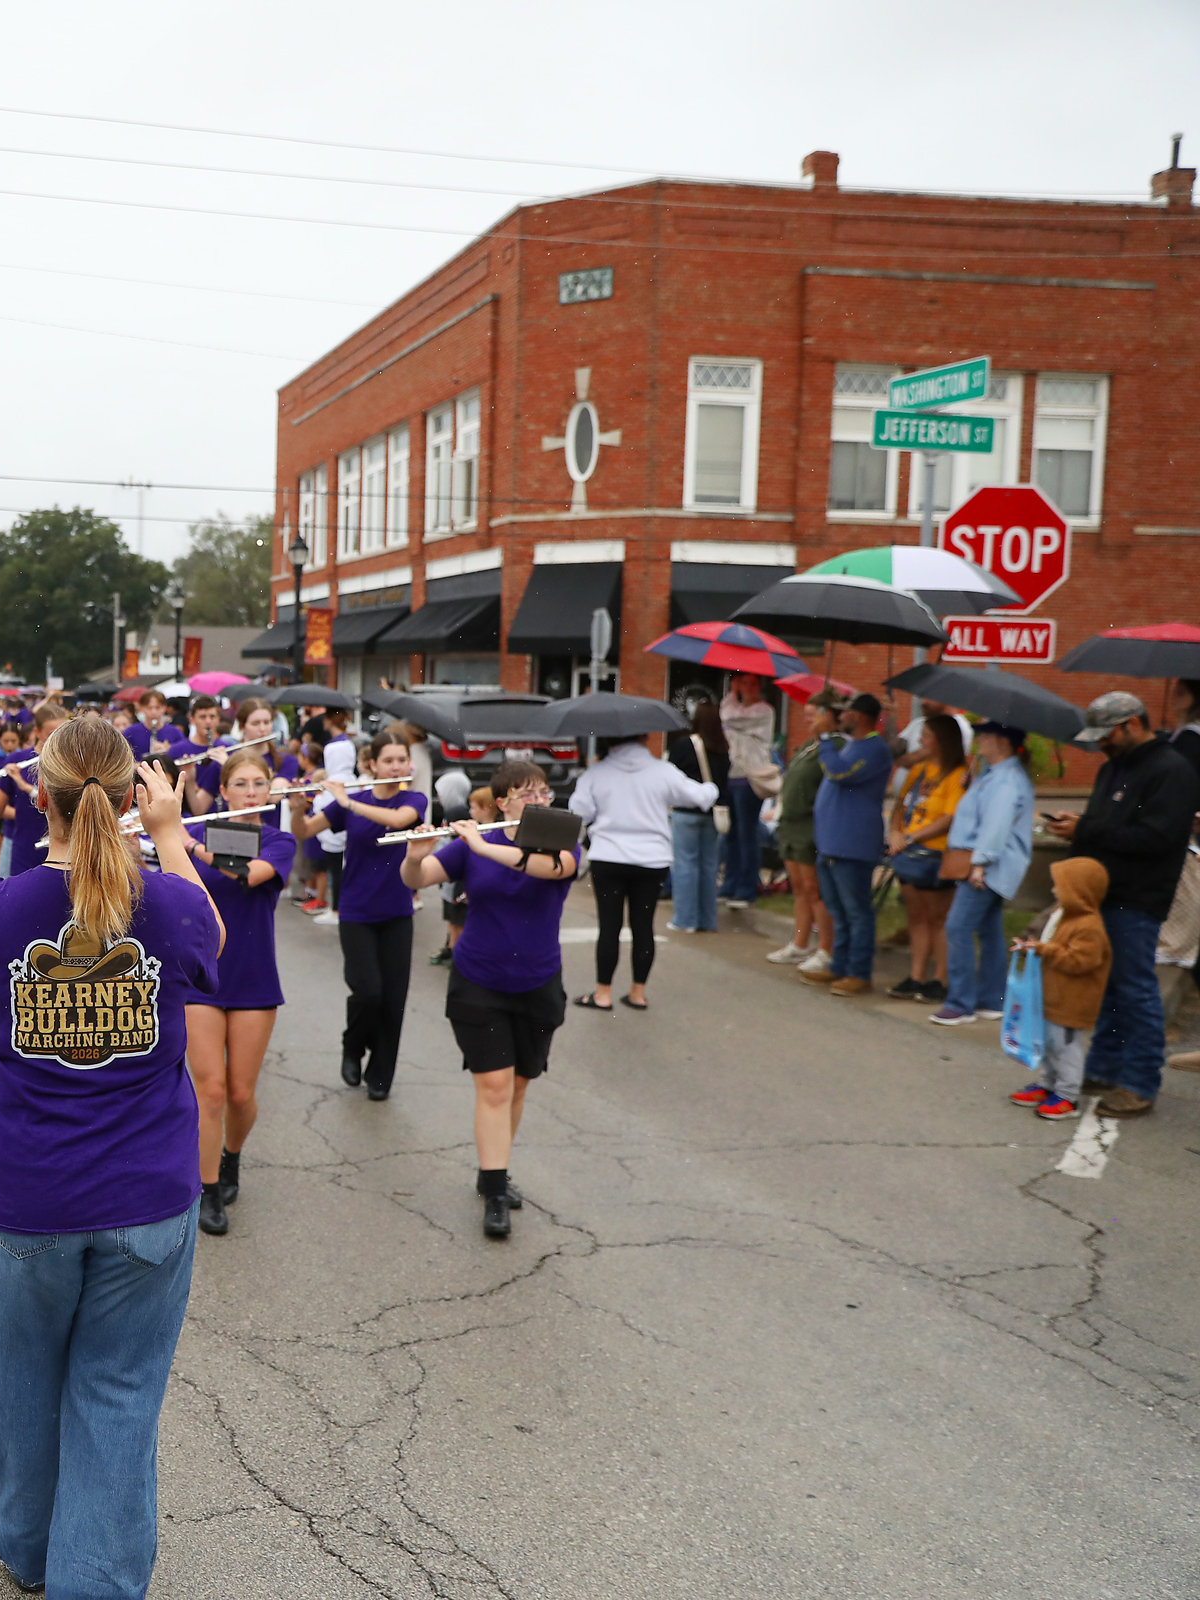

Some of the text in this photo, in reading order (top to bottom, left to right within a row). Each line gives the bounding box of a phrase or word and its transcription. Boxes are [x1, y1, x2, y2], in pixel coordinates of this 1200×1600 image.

[892, 370, 984, 406] WASHINGTON ST
[879, 418, 989, 445] JEFFERSON ST
[950, 524, 1061, 573] STOP
[947, 626, 1049, 653] ALL WAY
[16, 982, 154, 1007] KEARNEY
[17, 1006, 153, 1033] BULLDOG
[17, 1030, 153, 1048] MARCHING BAND
[71, 1049, 100, 1059] 2026
